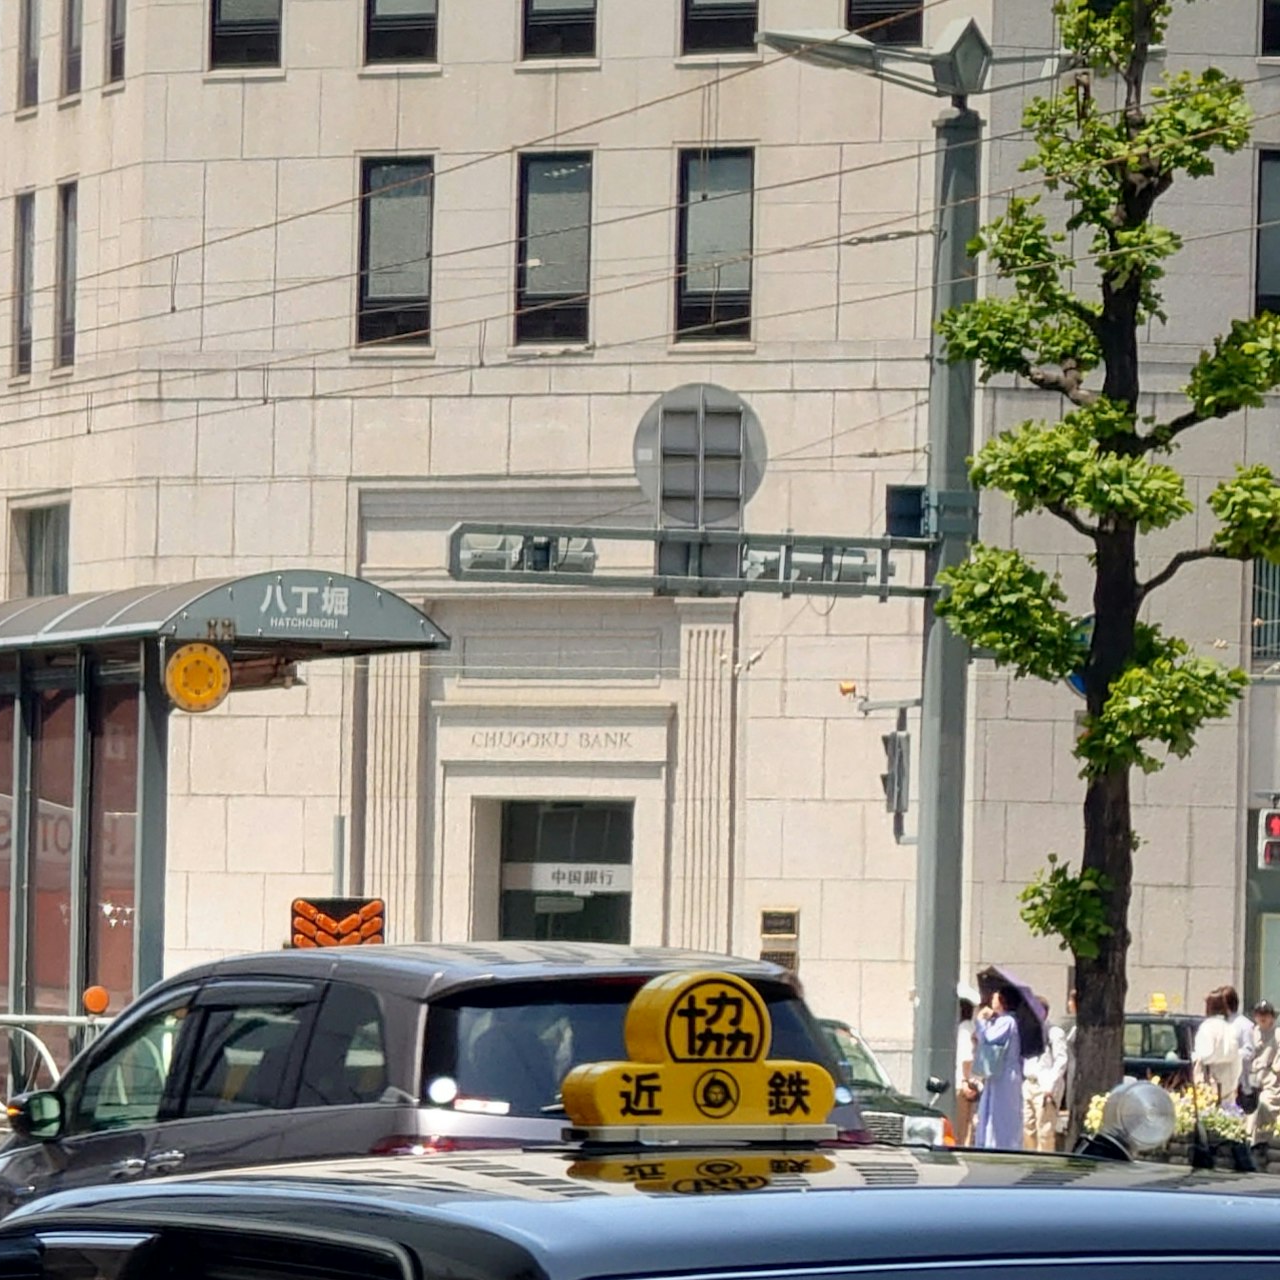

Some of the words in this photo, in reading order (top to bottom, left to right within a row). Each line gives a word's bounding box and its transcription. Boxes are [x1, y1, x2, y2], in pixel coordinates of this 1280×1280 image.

[260, 585, 350, 615] 八丁堀
[270, 616, 339, 629] HATCHOBORI
[471, 731, 569, 748] CHUGOKU
[579, 732, 633, 748] BANK
[550, 868, 615, 886] 中国銀行
[676, 991, 755, 1057] 協
[618, 1071, 664, 1117] 近
[766, 1070, 811, 1117] 鉄
